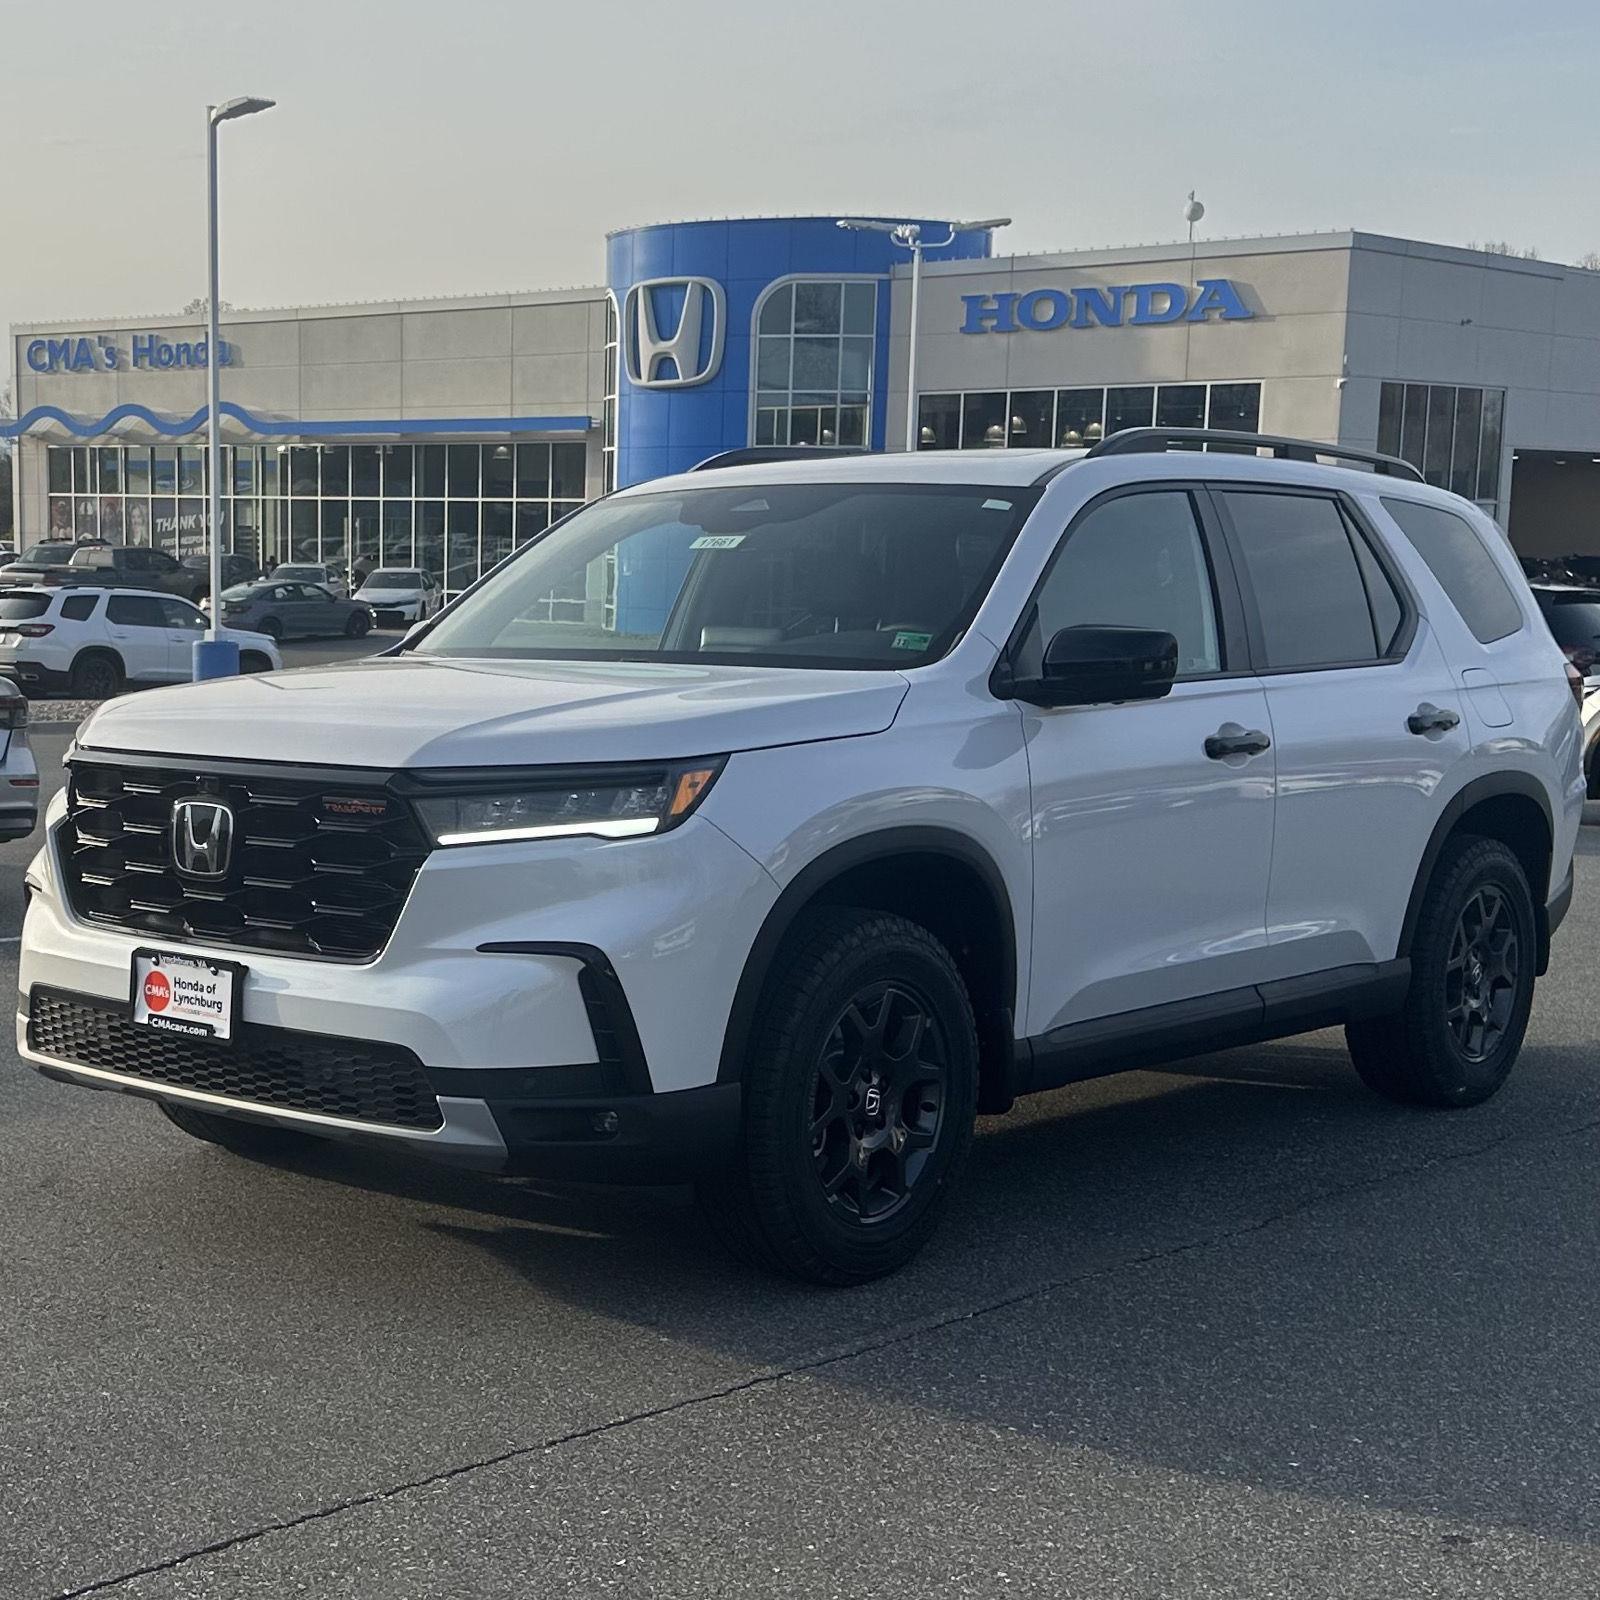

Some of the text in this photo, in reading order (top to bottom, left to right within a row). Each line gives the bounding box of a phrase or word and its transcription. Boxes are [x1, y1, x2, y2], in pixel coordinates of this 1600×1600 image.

[959, 279, 1252, 334] HONDA
[27, 331, 232, 373] CMA's Honda
[156, 514, 197, 533] THANK
[145, 984, 170, 999] CMA's
[173, 977, 217, 995] Honda of
[173, 991, 223, 1013] Lynchburg
[152, 1018, 208, 1037] CMAcars.com
